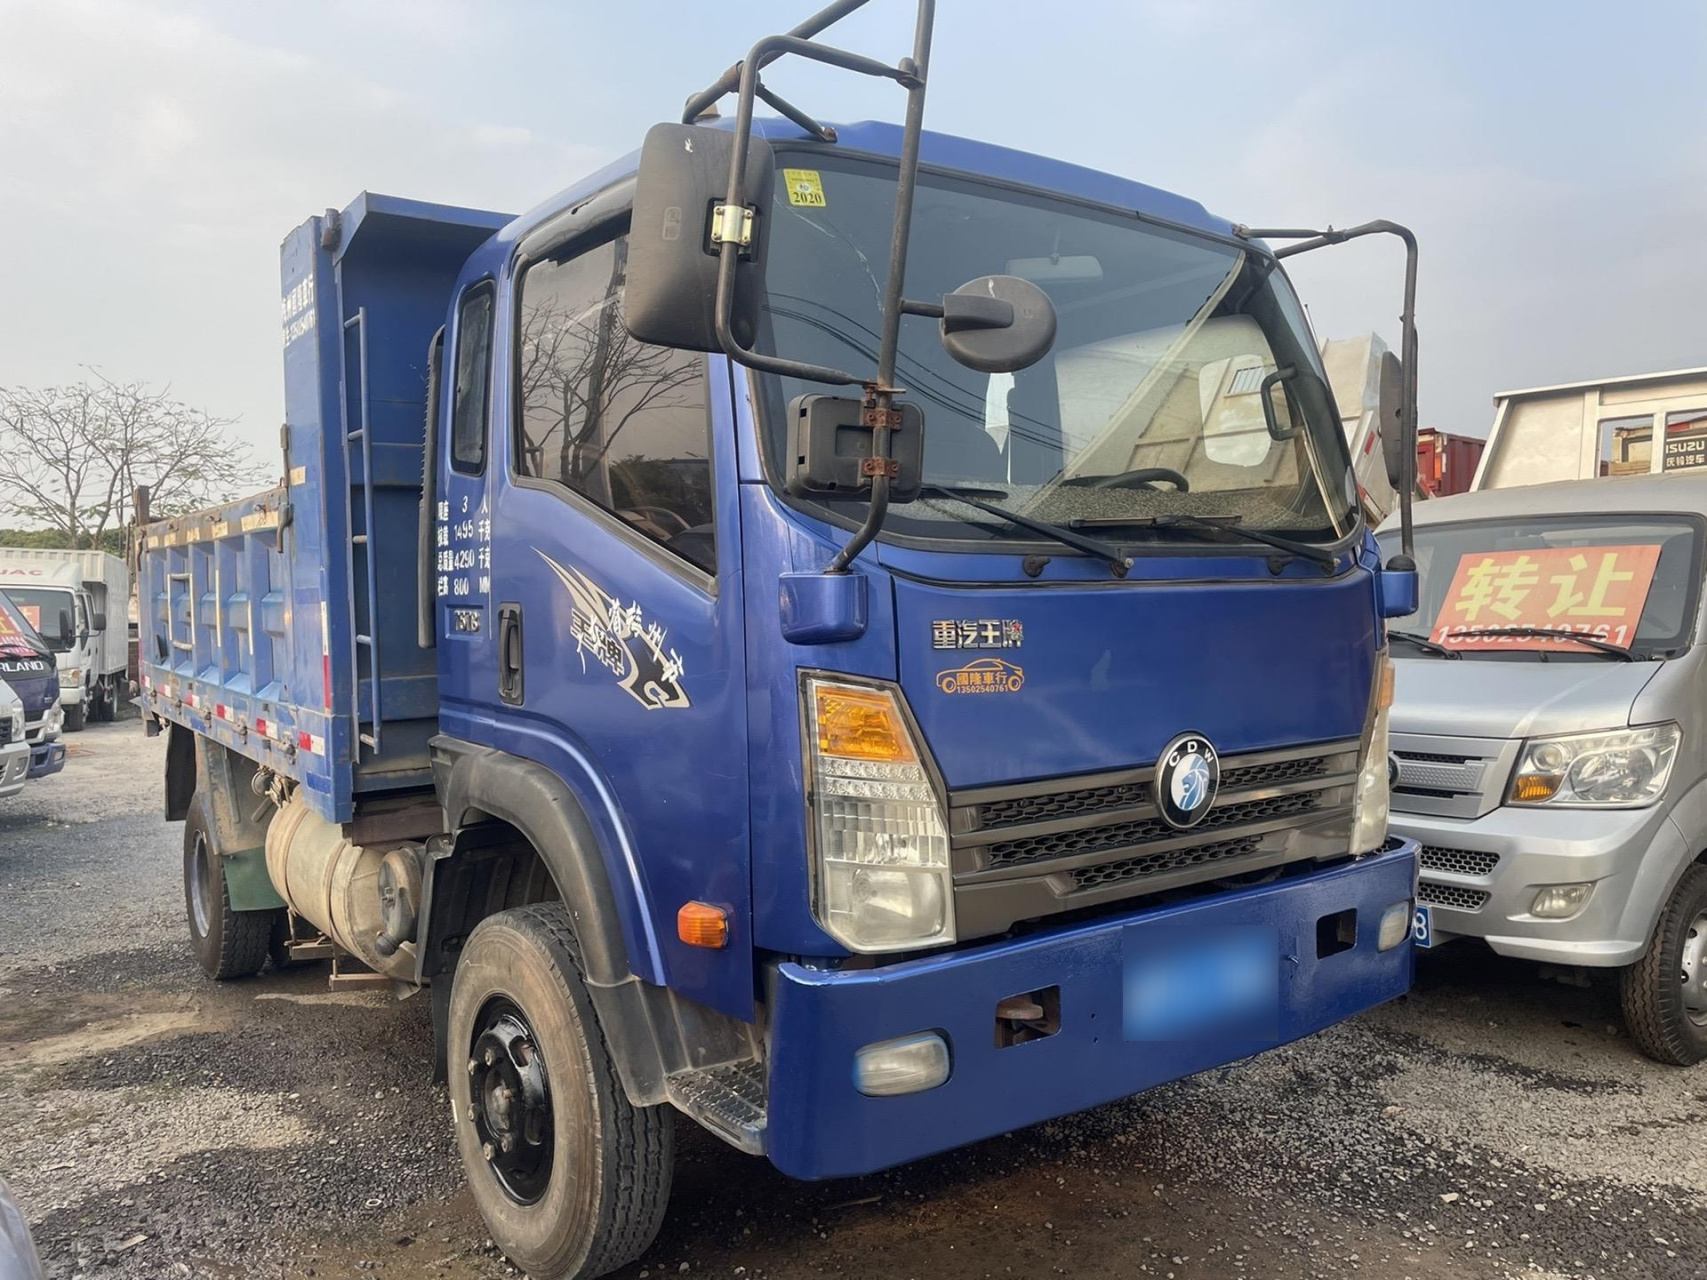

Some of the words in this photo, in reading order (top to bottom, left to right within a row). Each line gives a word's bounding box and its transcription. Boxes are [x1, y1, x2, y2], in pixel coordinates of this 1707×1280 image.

[793, 191, 822, 204] 2020
[1666, 440, 1705, 454] ISUZU
[462, 495, 468, 513] 3
[454, 519, 474, 541] 1495
[454, 549, 475, 570] 4290
[453, 577, 469, 595] 800
[1455, 553, 1634, 621] 转让
[932, 619, 1023, 649] 重汽王牌
[957, 684, 1008, 694] 13502540761
[1169, 741, 1214, 767] CDW
